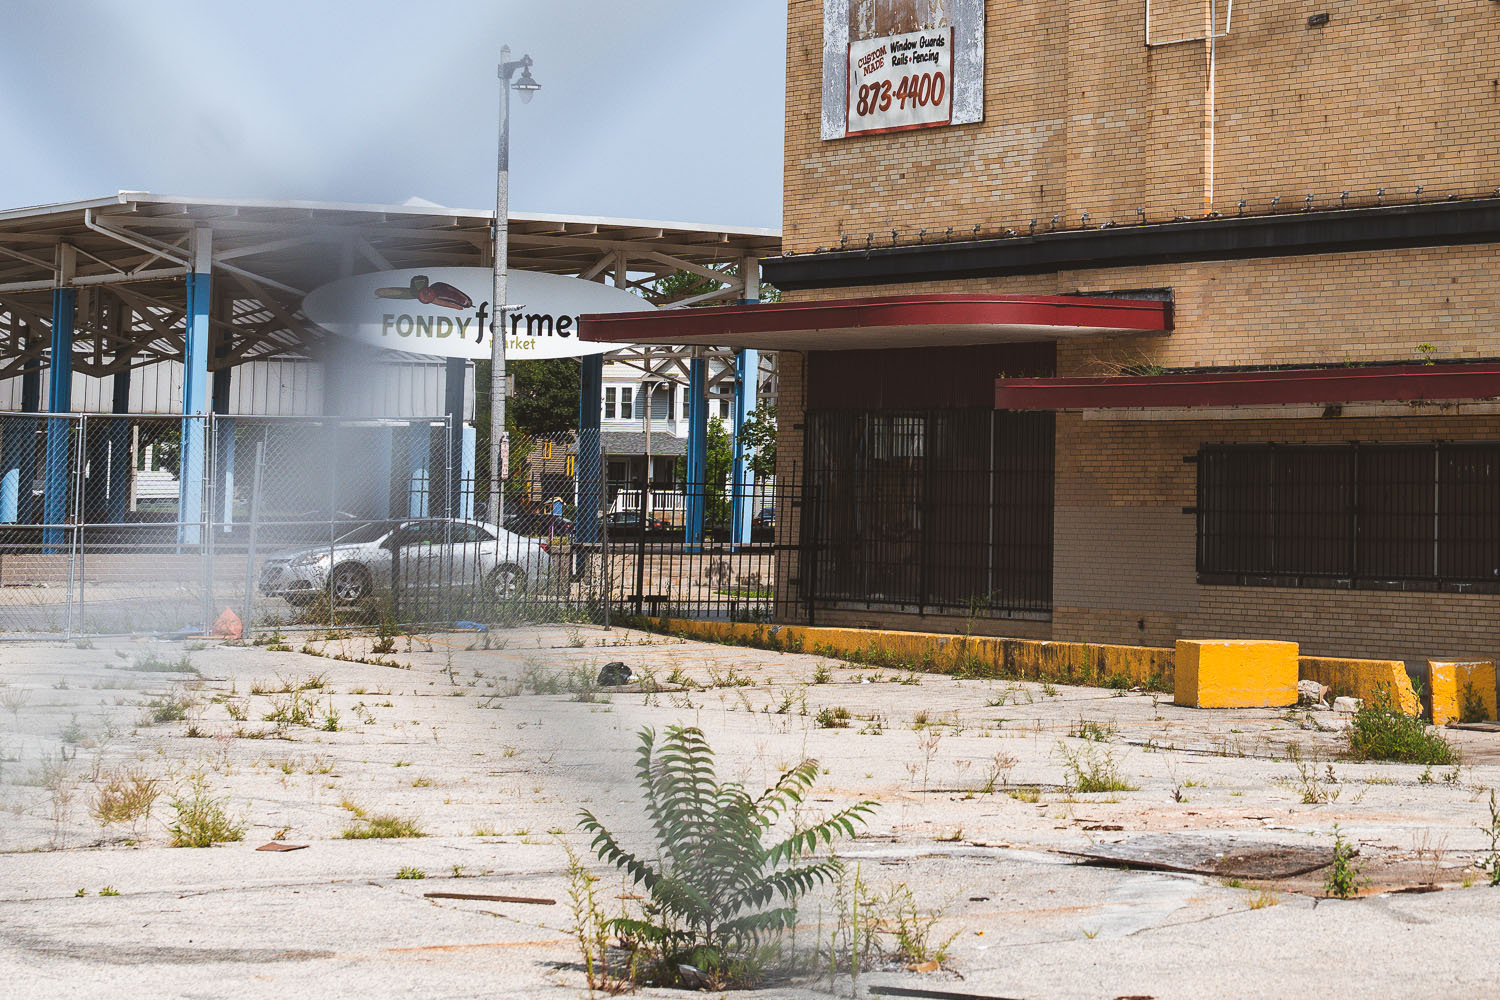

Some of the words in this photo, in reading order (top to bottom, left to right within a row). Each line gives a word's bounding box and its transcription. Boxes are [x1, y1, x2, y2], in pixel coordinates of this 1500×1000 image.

[890, 37, 917, 54] Window
[919, 34, 945, 48] Guards
[857, 45, 887, 68] CUSTOM
[891, 53, 908, 67] Rails
[913, 49, 940, 64] Fencing
[863, 57, 885, 77] MADE
[381, 313, 473, 340] FONDY
[489, 335, 536, 351] rket
